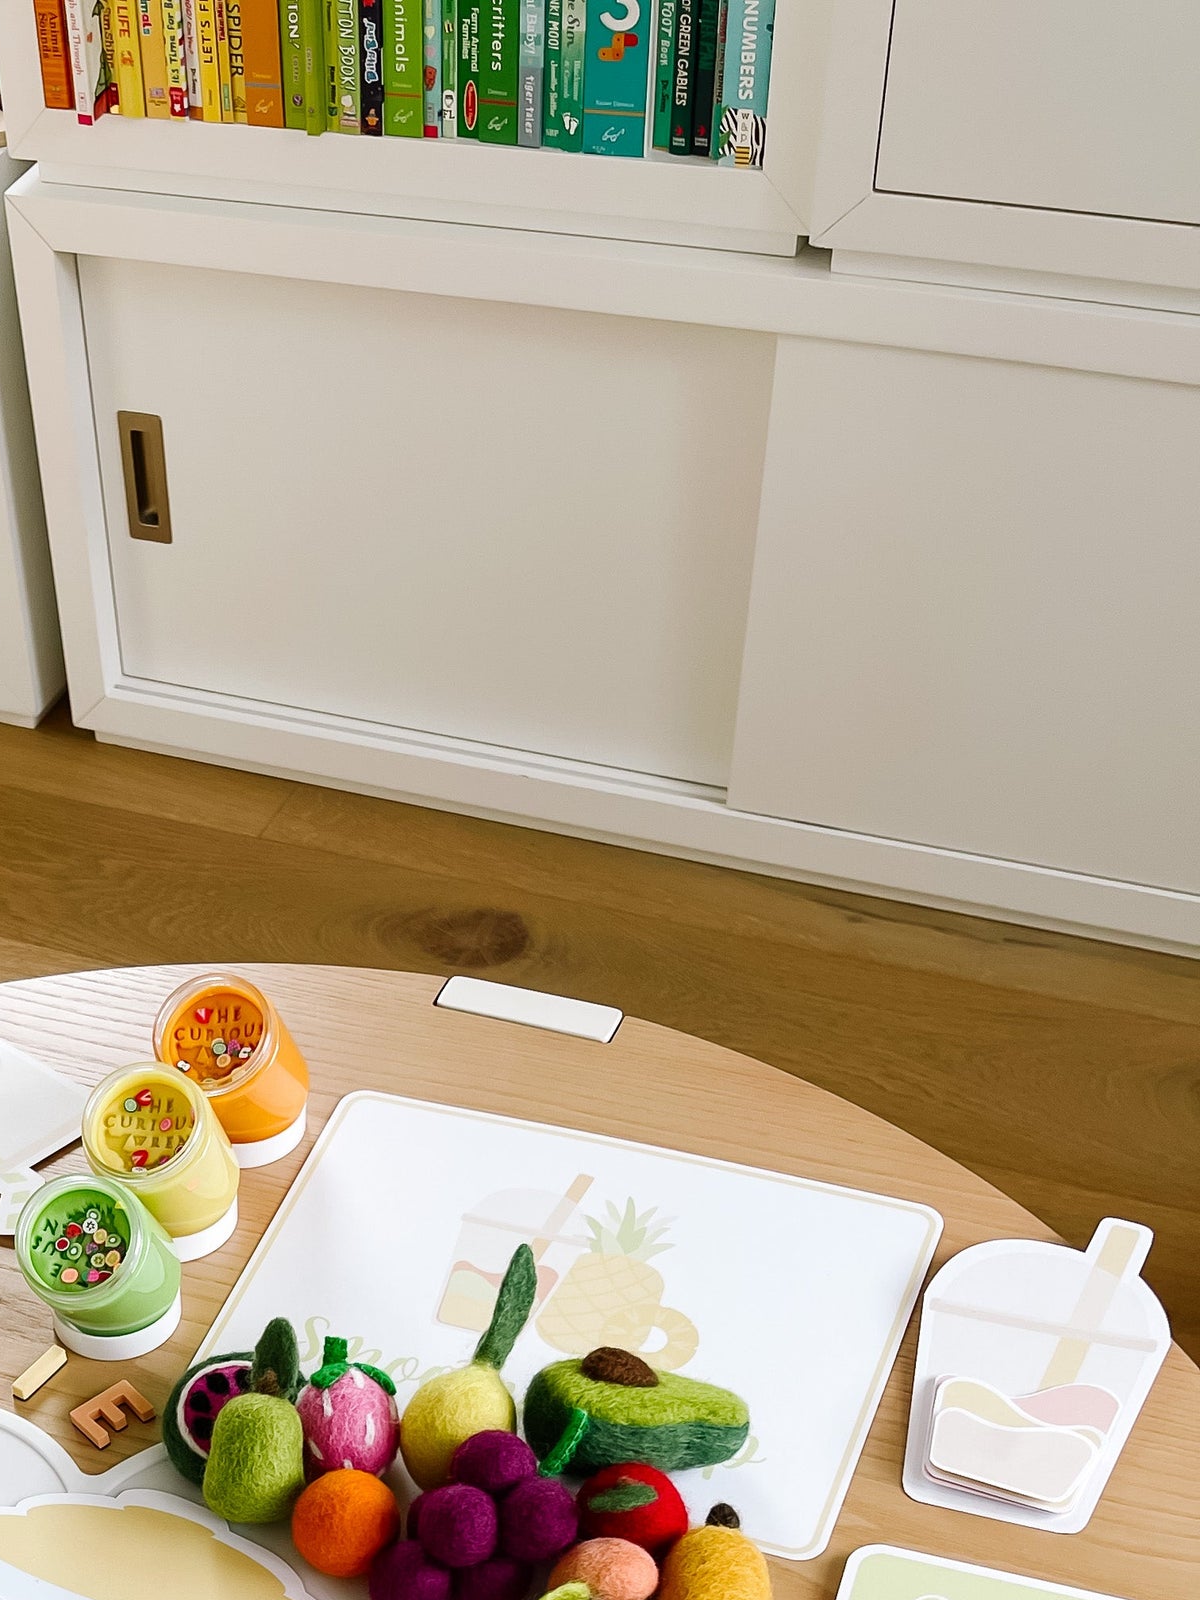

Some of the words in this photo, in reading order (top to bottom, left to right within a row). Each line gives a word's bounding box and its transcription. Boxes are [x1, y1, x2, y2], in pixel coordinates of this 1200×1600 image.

[38, 13, 49, 59] Sounds
[49, 12, 62, 58] Animal
[70, 14, 80, 31] and
[117, 5, 131, 39] LIFE
[166, 12, 176, 30] for
[226, 2, 245, 78] SPIDER
[287, 0, 300, 49] TON!
[394, 0, 410, 73] nimals
[462, 18, 470, 60] Families
[471, 7, 479, 33] Farm
[524, 13, 537, 55] Baby!
[548, 20, 559, 50] MOO!
[566, 14, 580, 48] Sun
[661, 2, 675, 38] FOOT
[679, 14, 691, 56] GREEN
[71, 34, 84, 76] Through
[169, 36, 179, 66] Time
[200, 20, 214, 64] LET'S
[471, 36, 480, 73] Animal
[738, 0, 760, 101] NUMBERS
[338, 44, 357, 92] BOOK!
[675, 58, 689, 106] GABLES
[524, 75, 535, 106] tiger
[523, 108, 535, 135] tales
